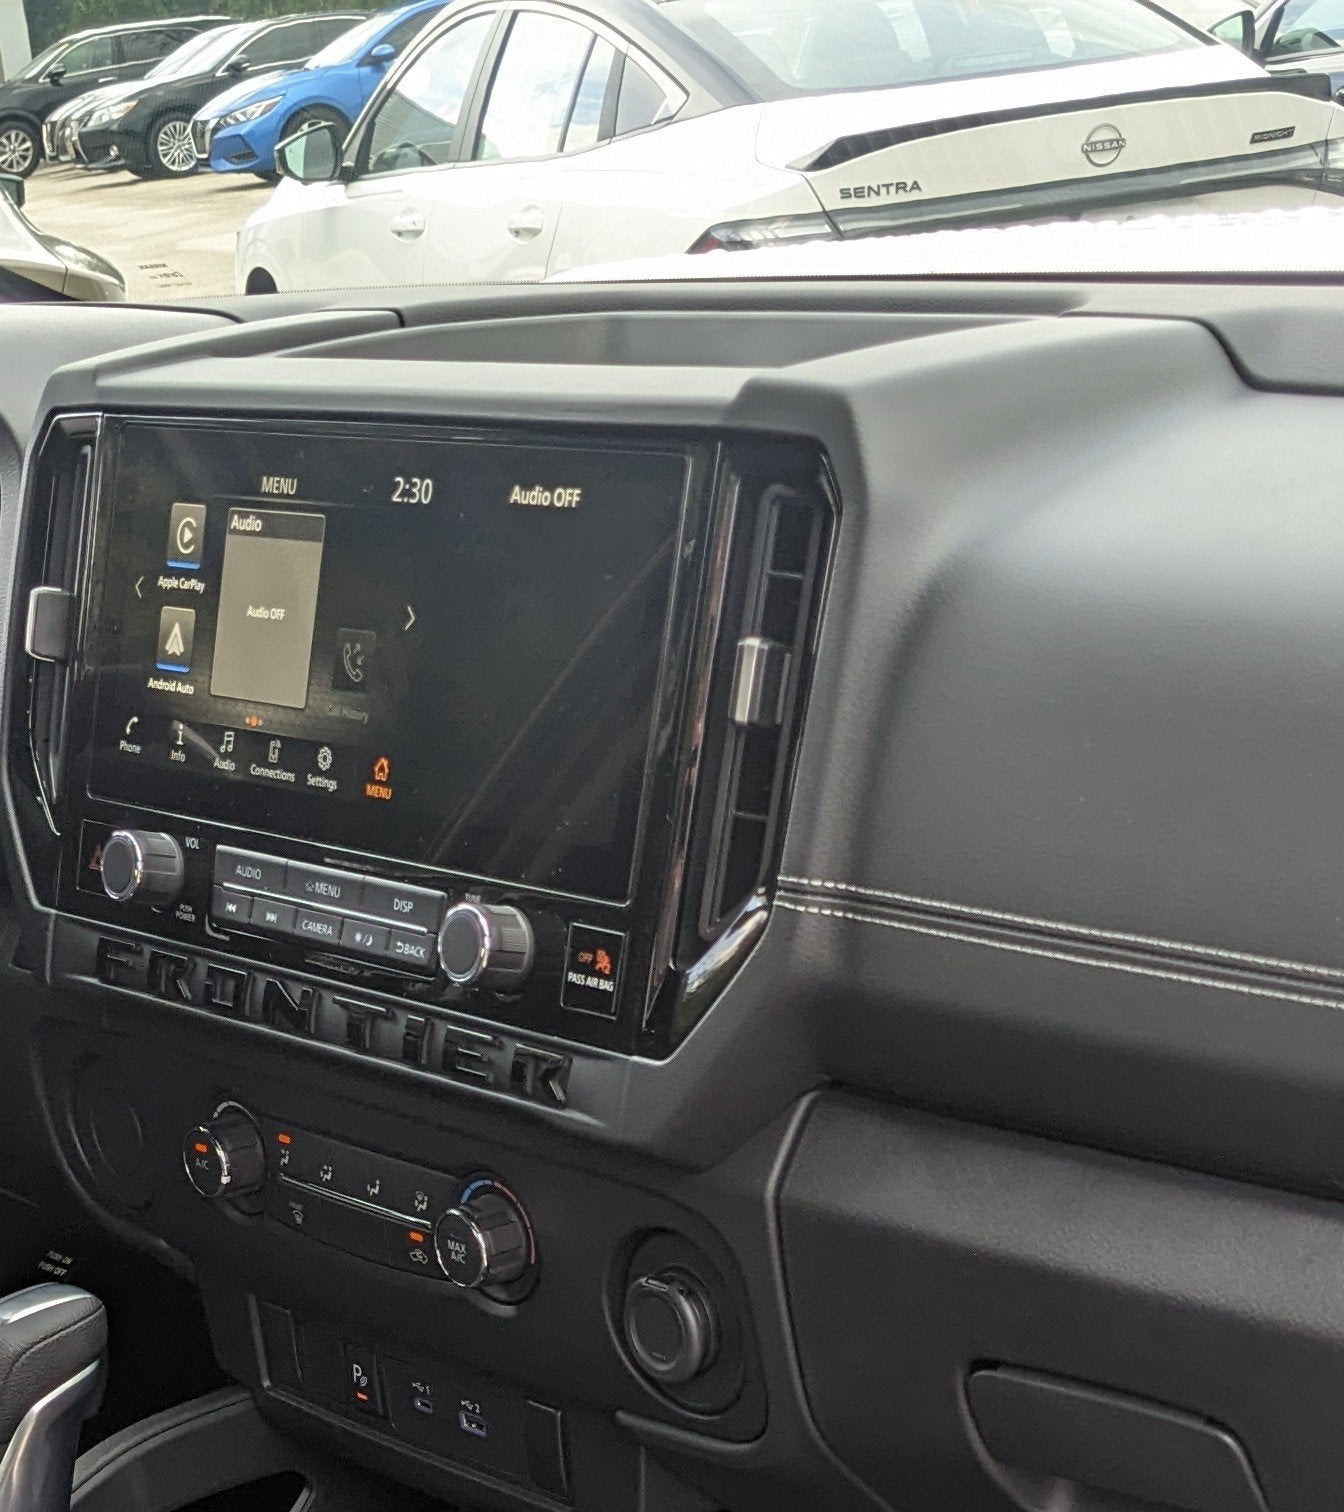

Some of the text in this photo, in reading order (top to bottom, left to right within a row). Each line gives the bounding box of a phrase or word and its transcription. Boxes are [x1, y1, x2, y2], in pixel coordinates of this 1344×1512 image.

[1083, 140, 1125, 151] NISSAN
[839, 179, 923, 200] SENTRA
[261, 476, 298, 495] MENU
[391, 476, 433, 505] 2:30
[510, 485, 582, 507] Audio OFF
[230, 514, 263, 532] Audio
[157, 576, 206, 593] Apple CarPlay
[247, 606, 285, 621] Audio OFF
[147, 677, 194, 695] Android Auto
[119, 740, 141, 754] Phone
[170, 750, 186, 763] Info
[213, 758, 236, 772] Audio
[250, 763, 296, 782] Connections
[306, 773, 338, 792] Settings
[366, 783, 393, 799] MENU
[185, 836, 199, 850] VOL
[235, 864, 262, 880] AUDIO
[314, 881, 341, 898] MENU
[393, 898, 414, 914] DISP
[302, 920, 333, 936] CAMERA
[404, 944, 426, 959] BACK
[98, 935, 572, 1108] FRONTIER
[195, 1158, 210, 1170] A/C
[448, 1239, 467, 1253] MAX
[451, 1251, 466, 1264] A/C
